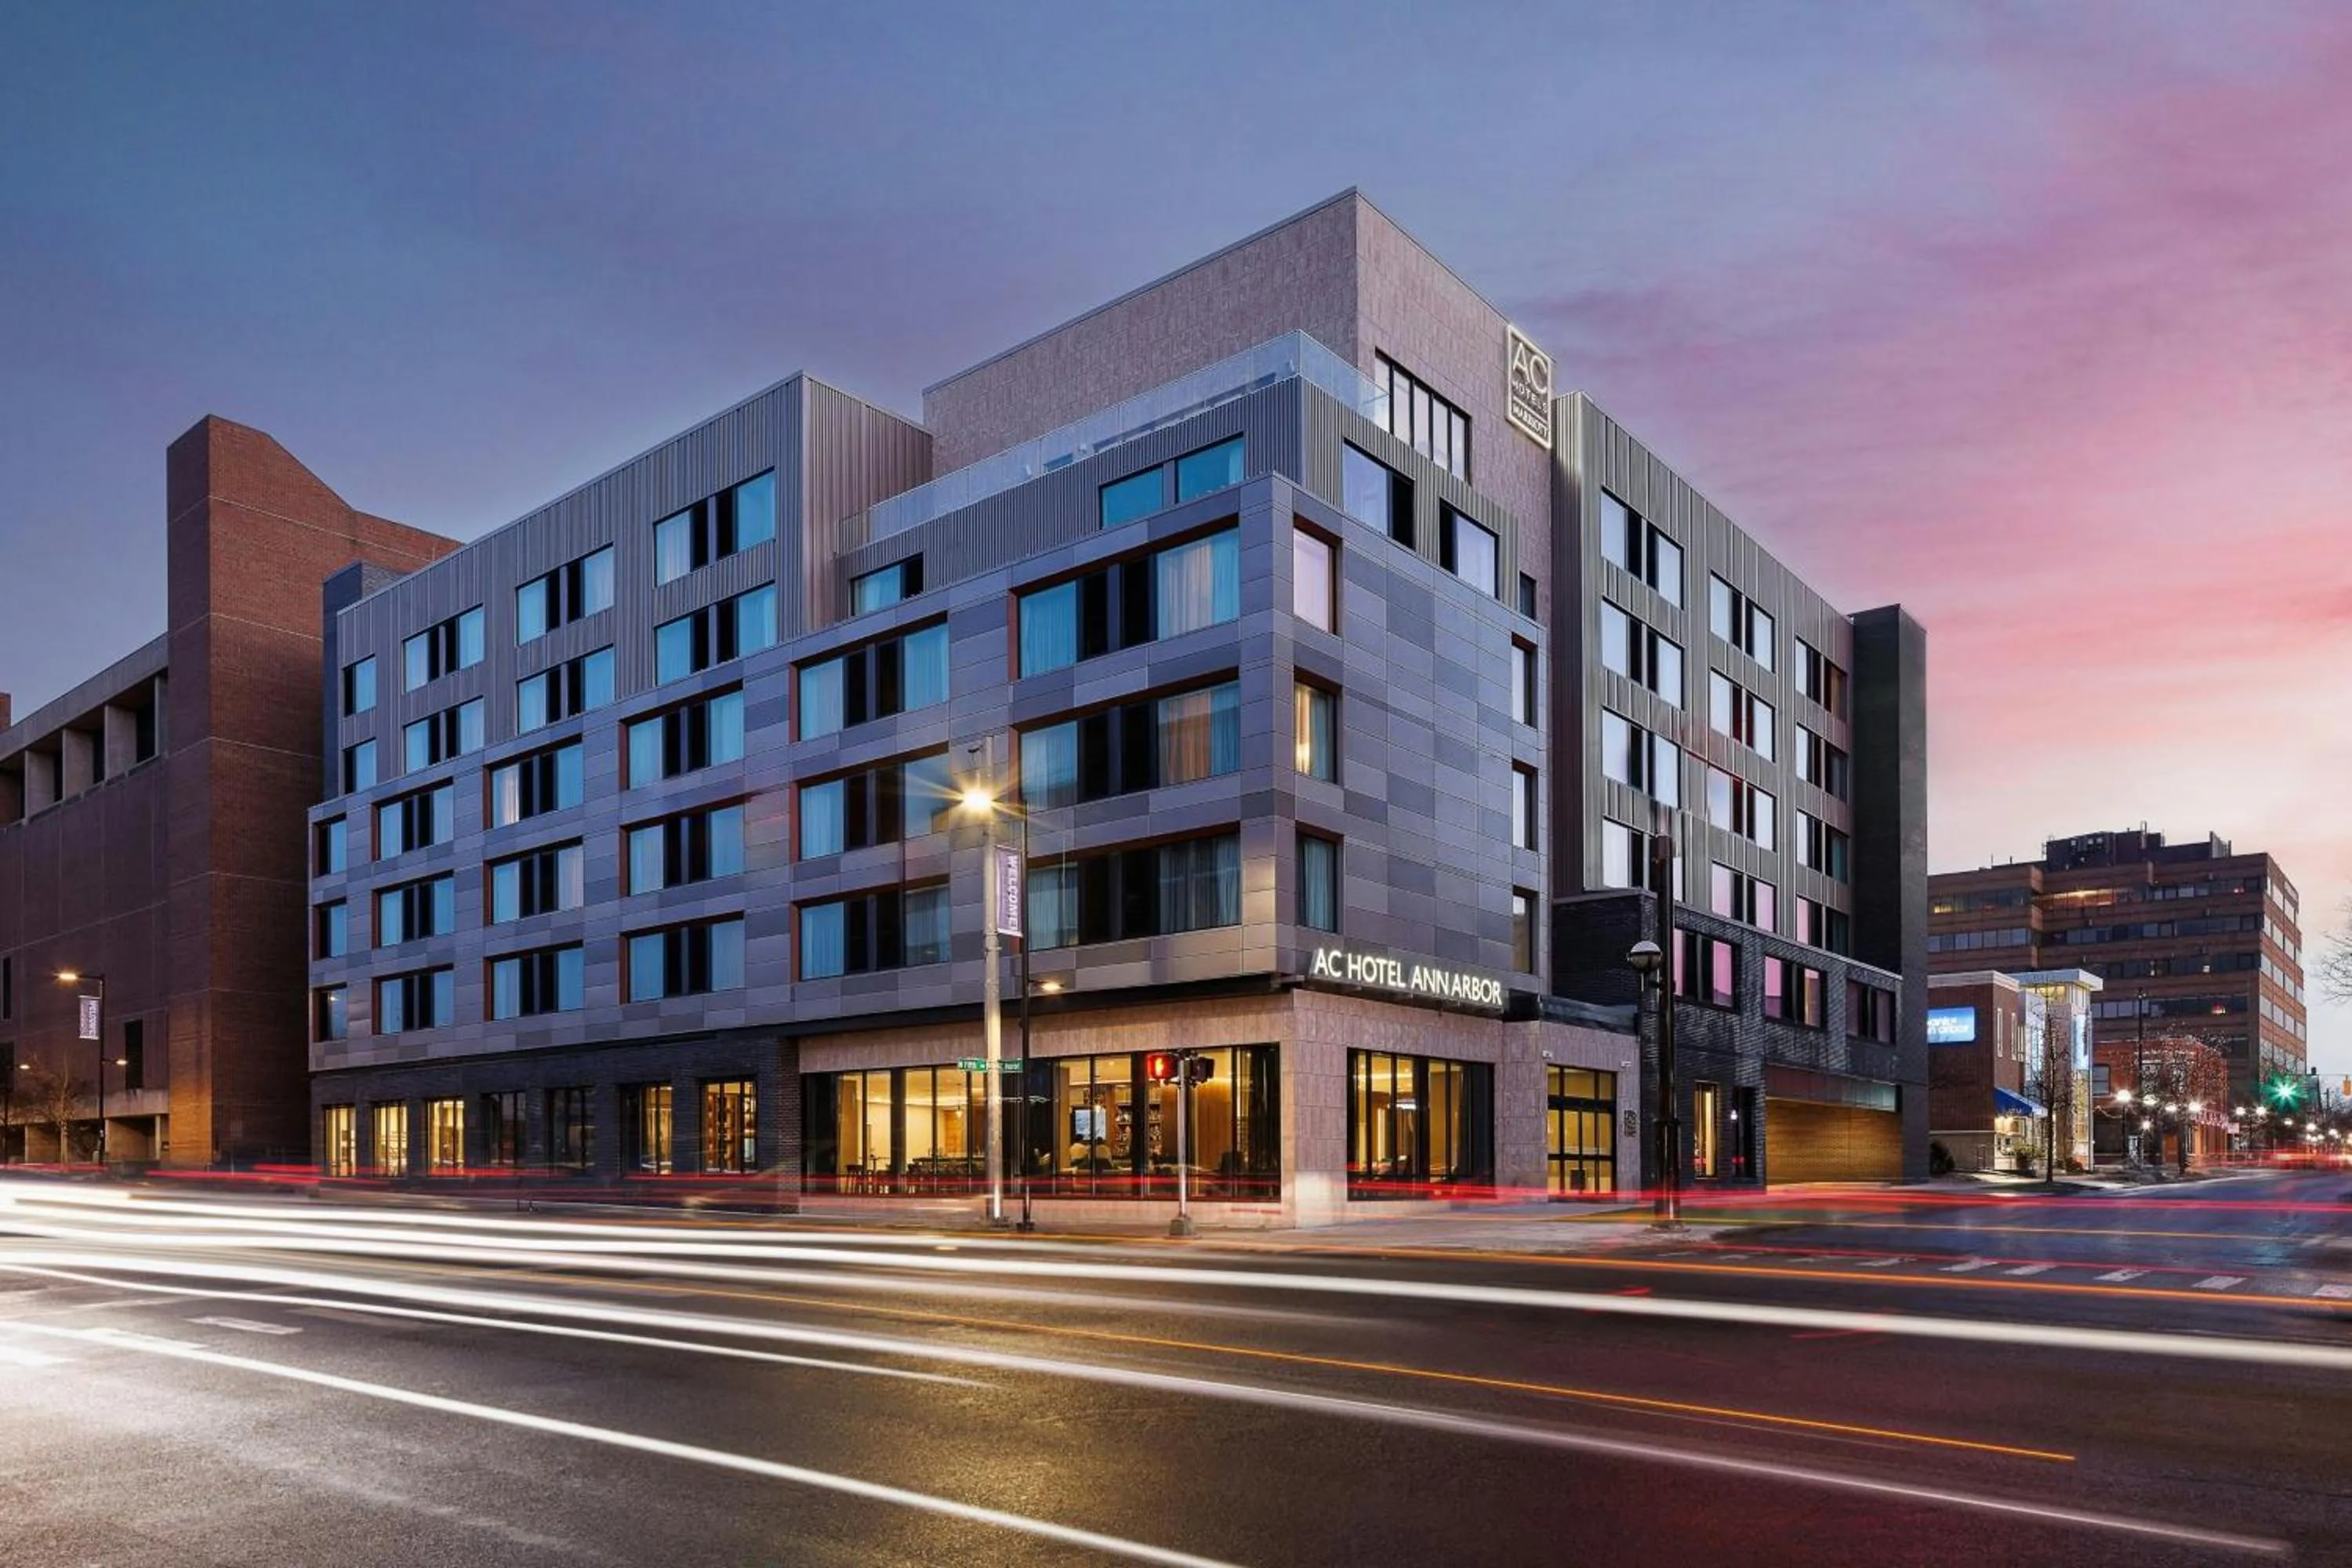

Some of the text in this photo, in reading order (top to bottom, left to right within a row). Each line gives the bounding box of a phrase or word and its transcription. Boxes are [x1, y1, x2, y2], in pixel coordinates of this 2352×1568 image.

[1512, 342, 1548, 394] AC
[1007, 855, 1019, 931] WELCOME
[1314, 947, 1503, 1006] AC HOTEL ANN ARBOR
